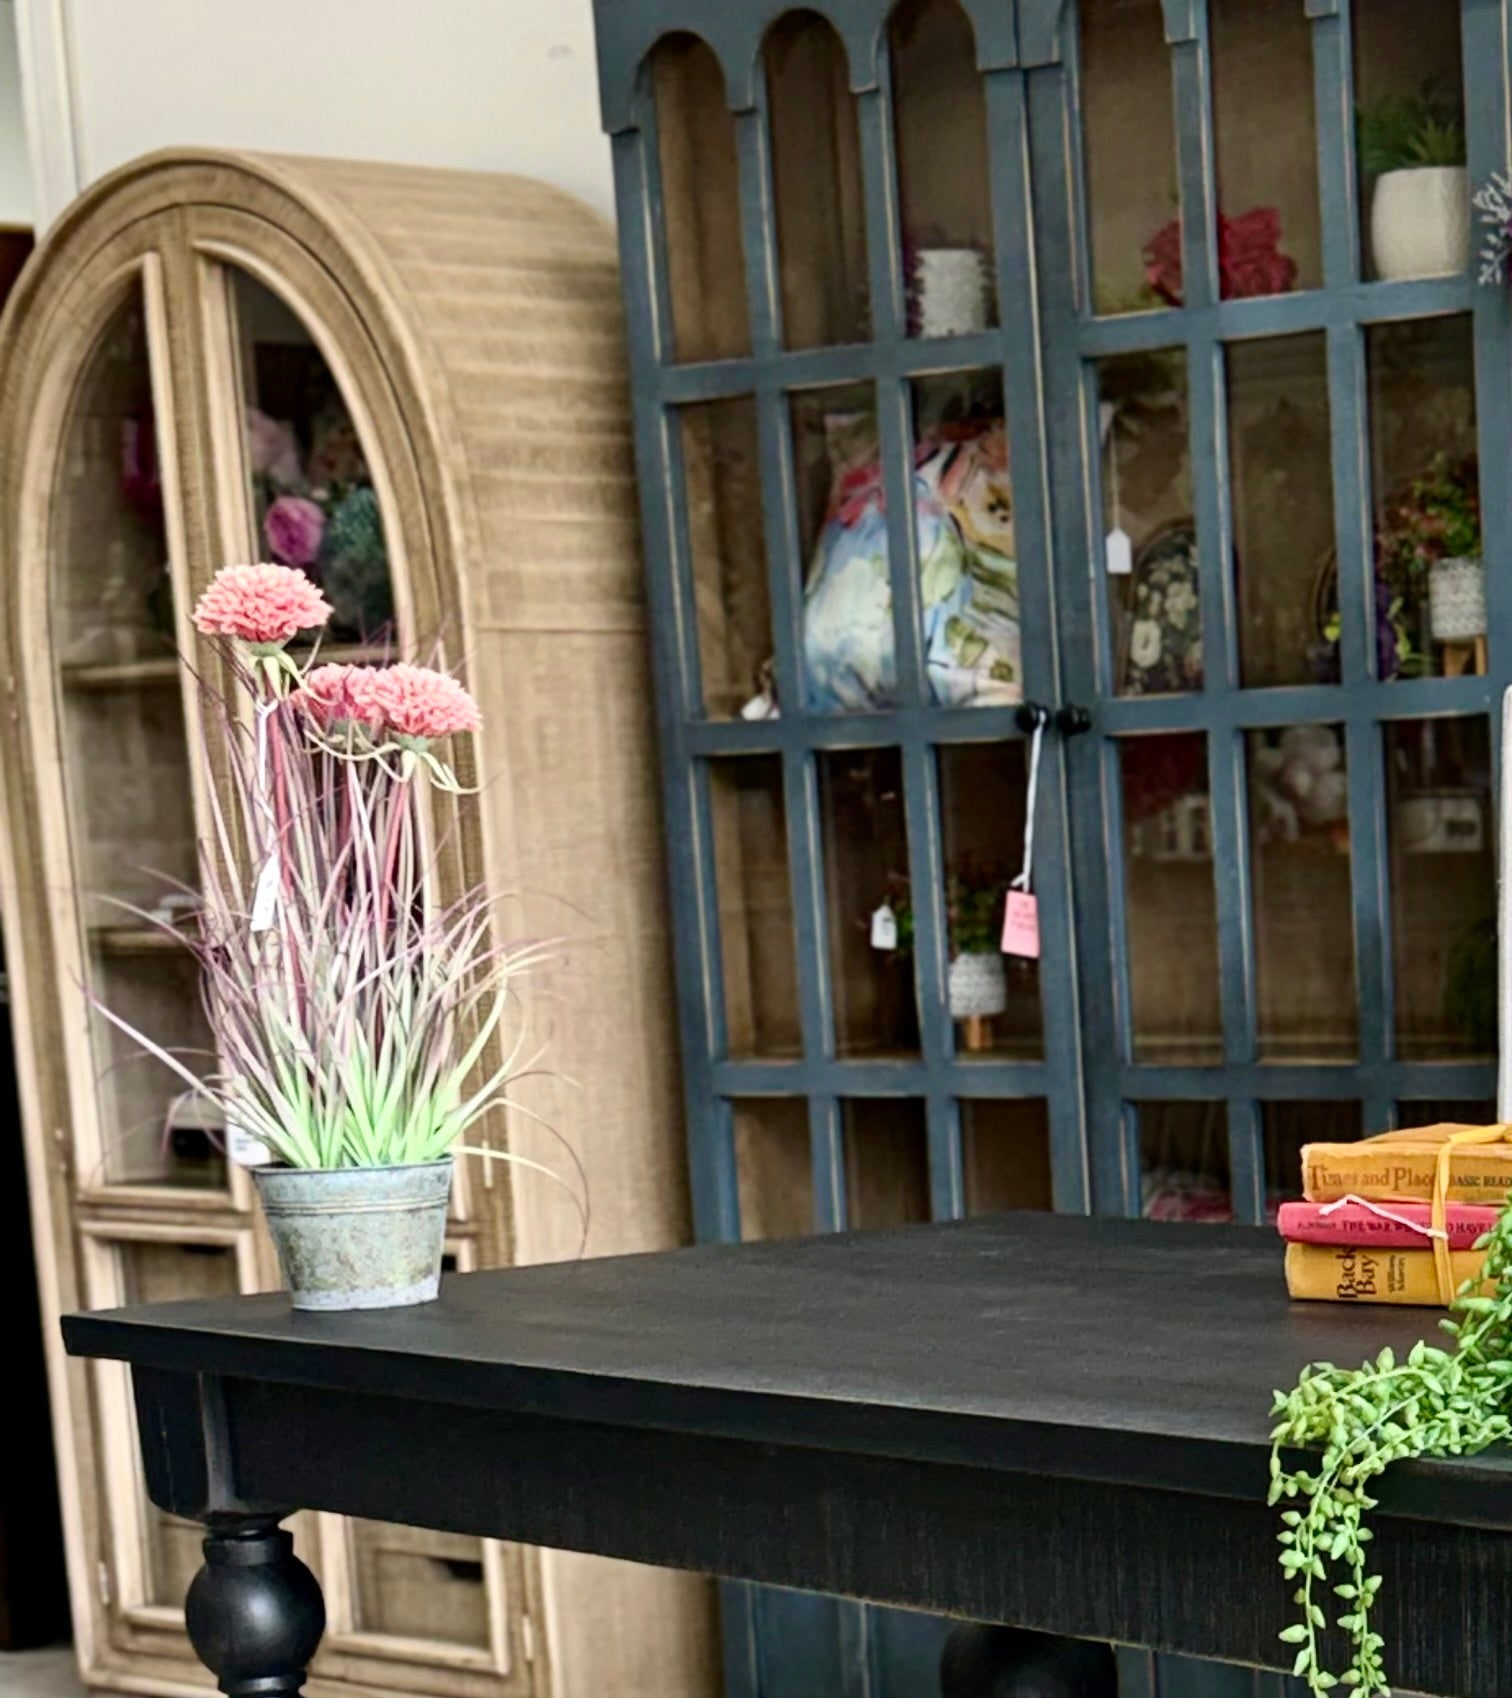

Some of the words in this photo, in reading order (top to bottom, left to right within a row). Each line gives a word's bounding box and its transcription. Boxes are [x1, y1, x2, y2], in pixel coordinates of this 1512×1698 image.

[1361, 1167, 1390, 1187] and
[1392, 1167, 1436, 1191] Plac
[1336, 1246, 1358, 1298] Back
[1356, 1254, 1379, 1295] Bay
